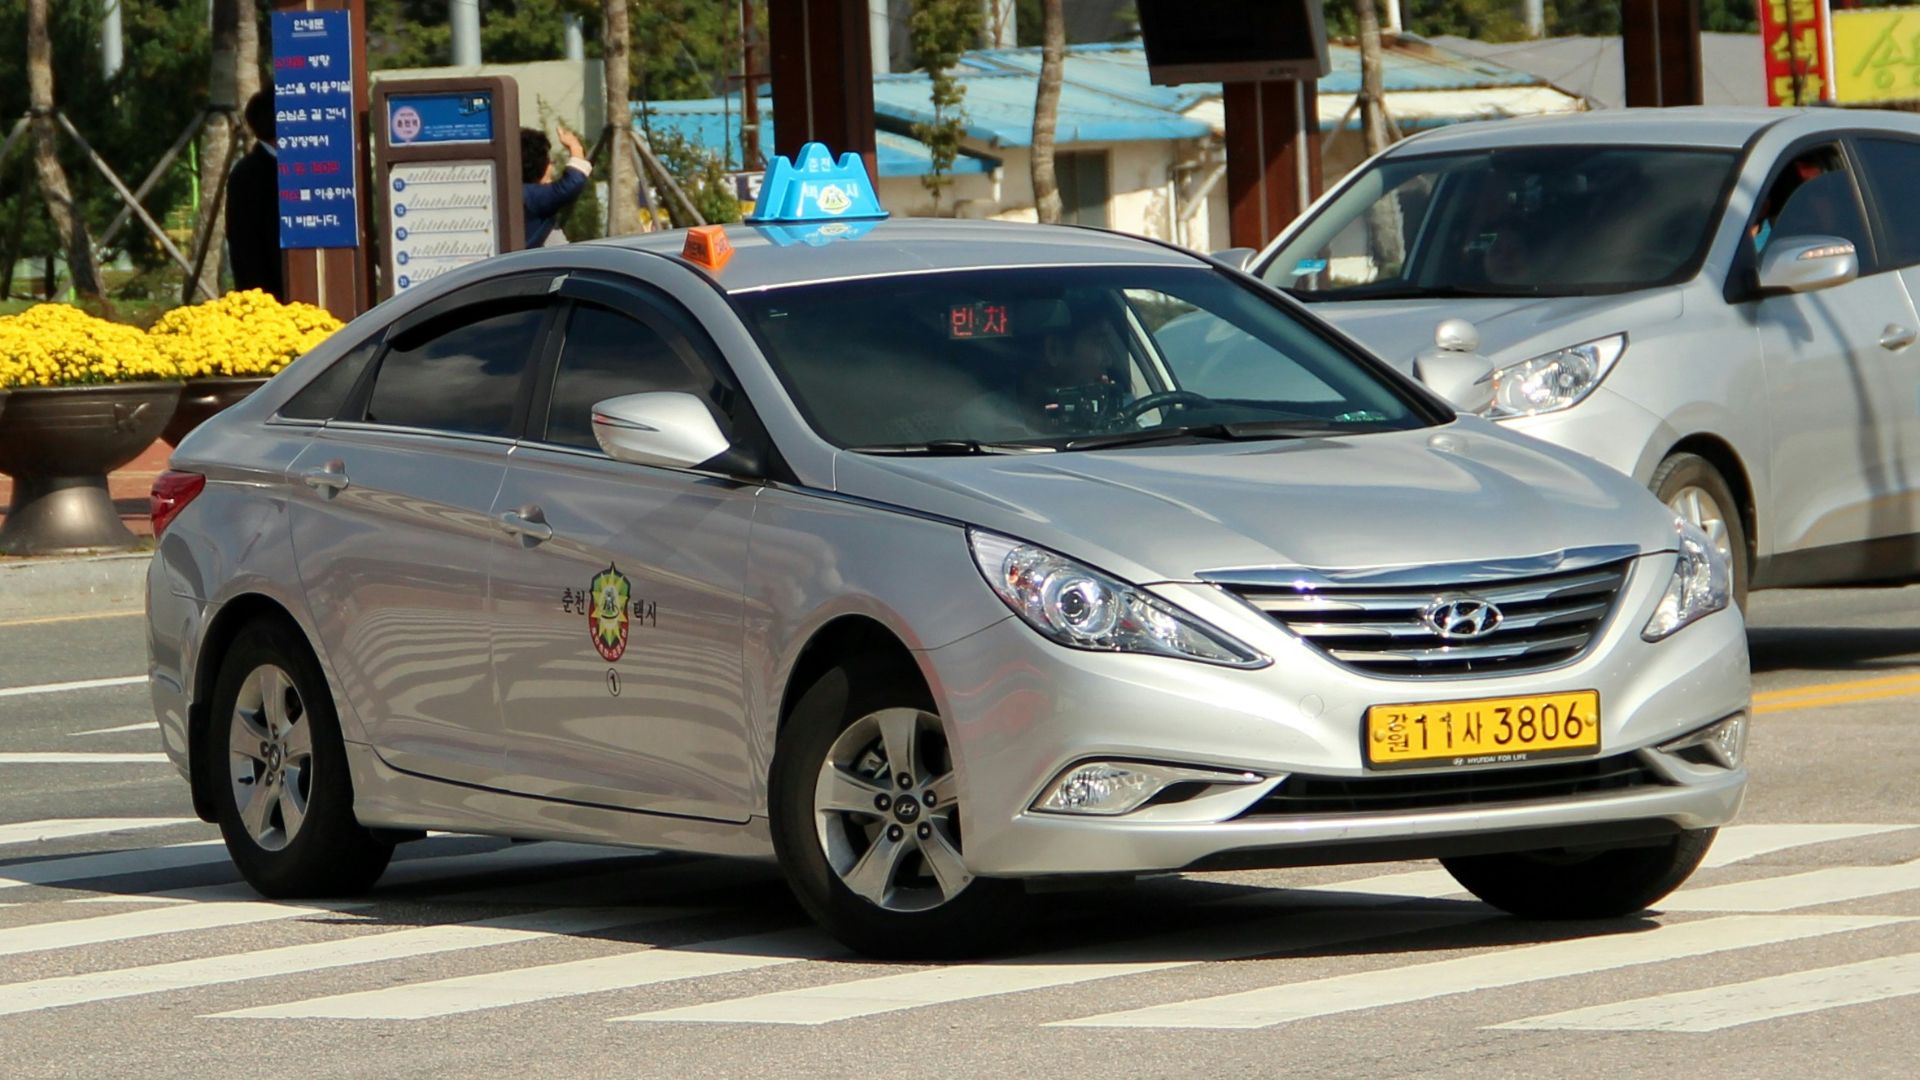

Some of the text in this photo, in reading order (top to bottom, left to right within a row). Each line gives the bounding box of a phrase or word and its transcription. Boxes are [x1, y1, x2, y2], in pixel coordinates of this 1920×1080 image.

[293, 18, 325, 31] 안내문
[308, 54, 330, 68] 방향
[275, 80, 351, 96] 노선을 이용하실
[276, 109, 307, 122] 손님은
[325, 107, 347, 120] 건너
[278, 135, 329, 149] 승강장에서
[314, 187, 355, 200] 이용하시
[281, 214, 340, 228] 기 바랍니다.
[562, 588, 657, 627] 춘천 택시
[1494, 702, 1583, 745] 3806
[1467, 753, 1527, 764] HYUNDAI FOR LIFE
